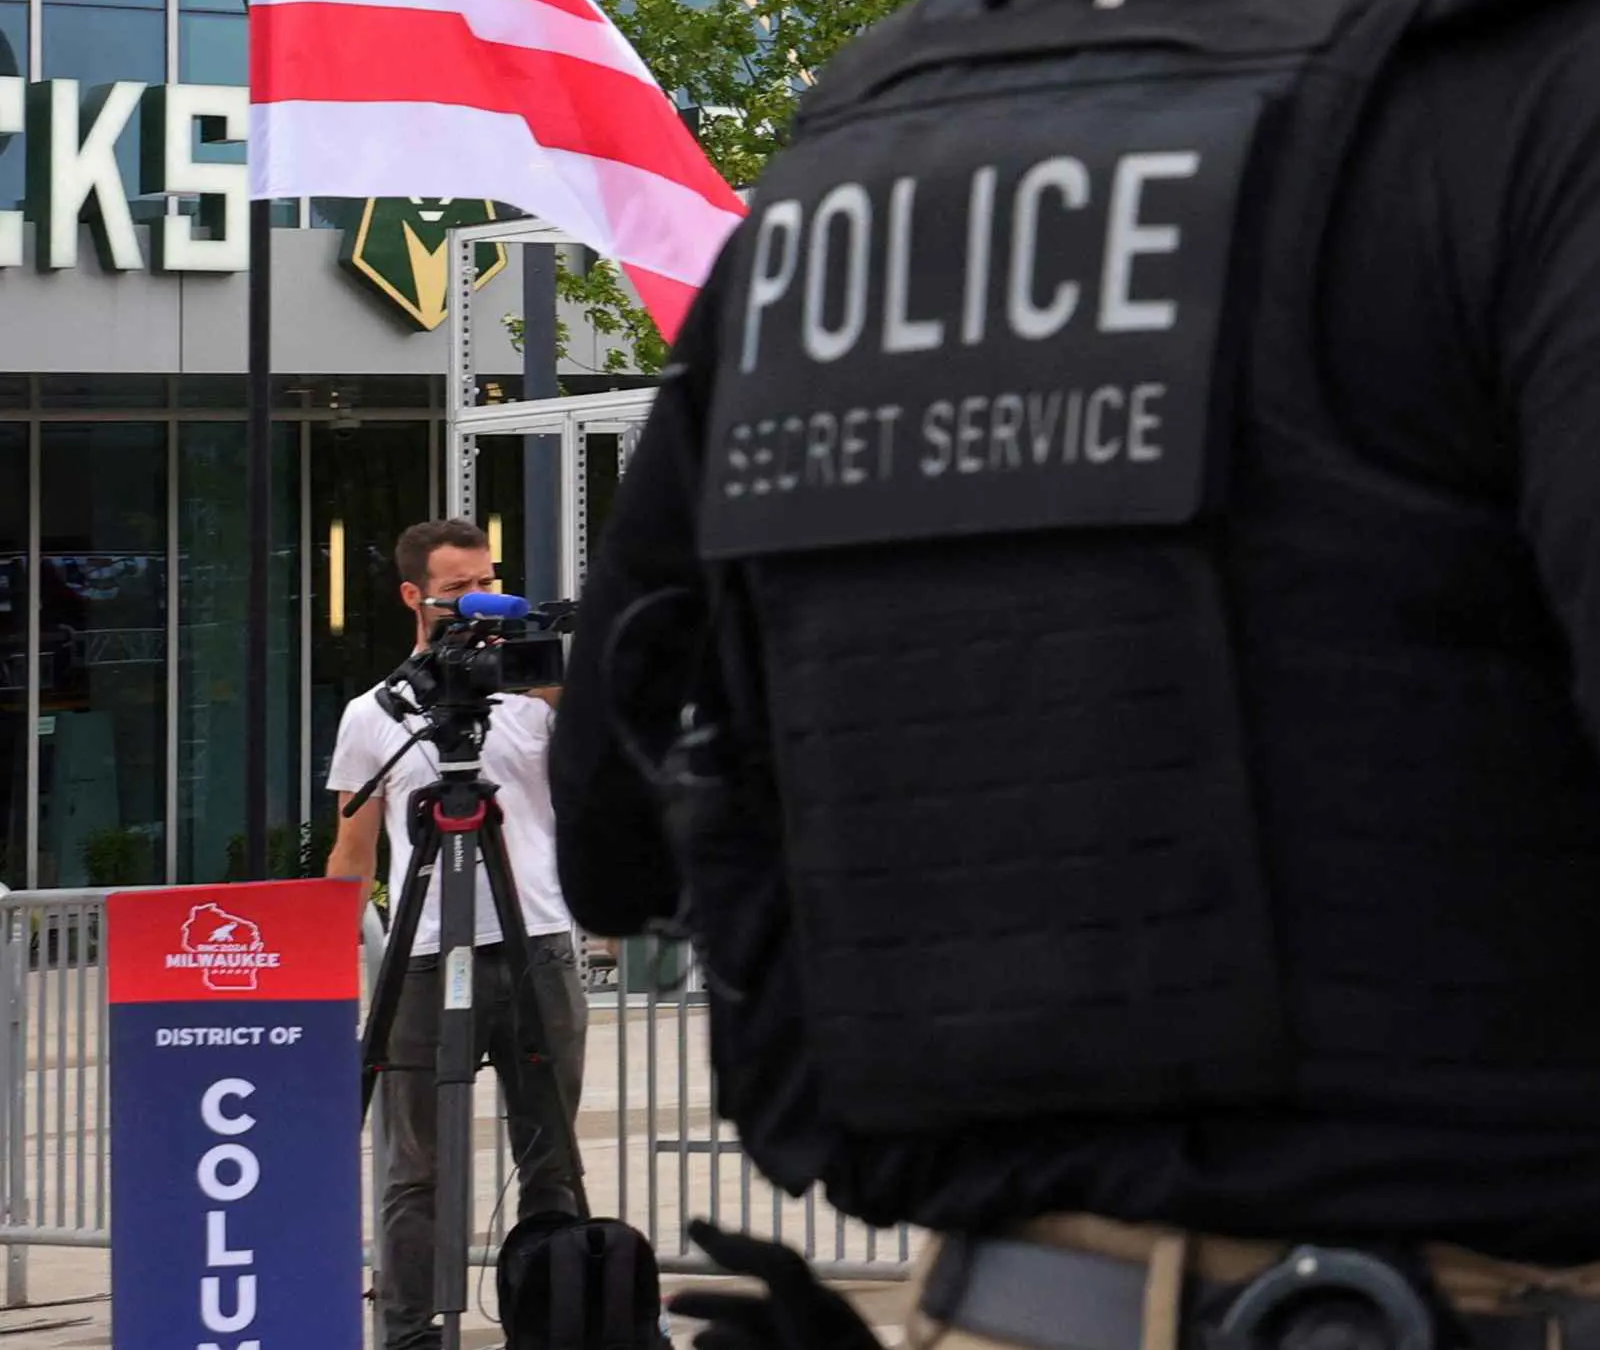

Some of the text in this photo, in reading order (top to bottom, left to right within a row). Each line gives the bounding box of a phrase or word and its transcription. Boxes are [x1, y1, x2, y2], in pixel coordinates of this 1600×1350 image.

[0, 77, 249, 273] KS
[739, 151, 1200, 374] POLICE
[723, 383, 1167, 497] SECRET SERVICE
[156, 1027, 303, 1046] DISTRICT OF
[165, 953, 280, 968] MILWAUKEE
[197, 1078, 260, 1350] COLU
